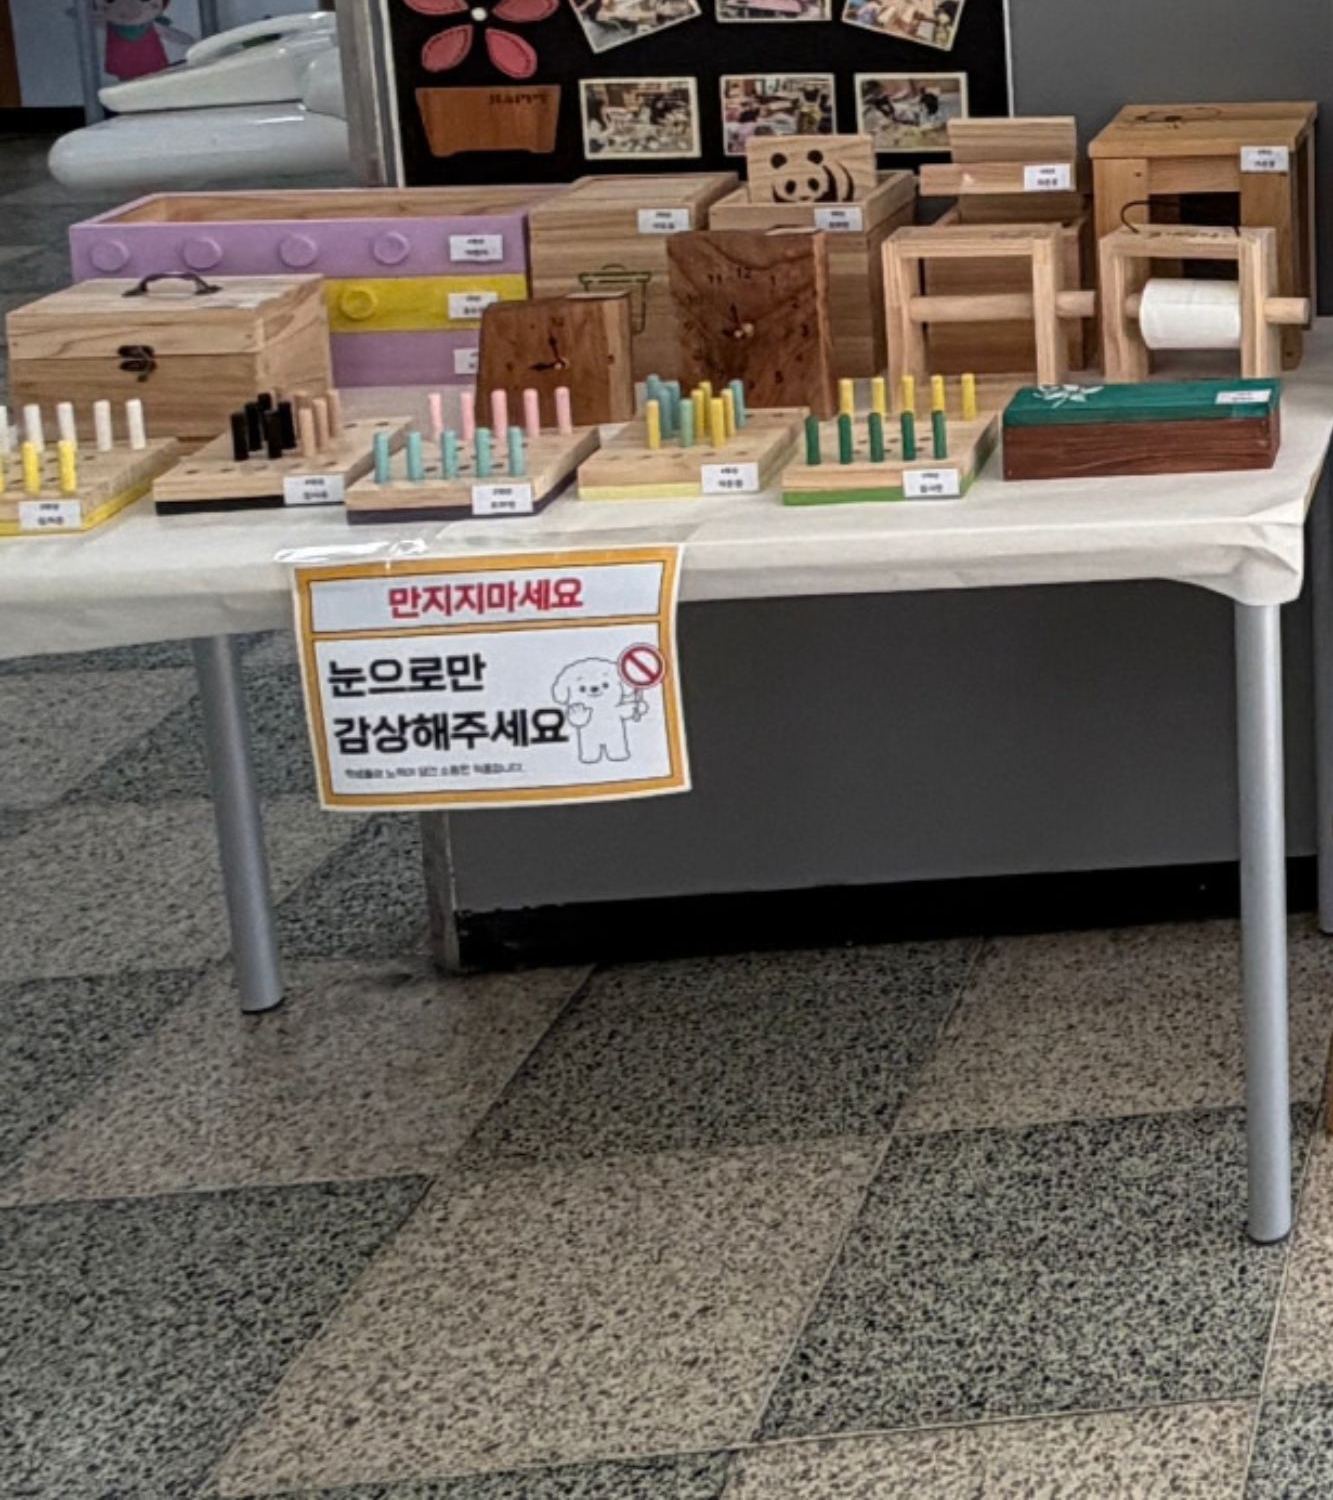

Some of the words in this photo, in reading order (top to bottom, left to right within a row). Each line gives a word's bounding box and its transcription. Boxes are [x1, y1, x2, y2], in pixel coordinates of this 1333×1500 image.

[388, 577, 583, 619] 만지지마세요
[327, 653, 487, 698] 눈으로만
[333, 707, 569, 756] 감상해주세요
